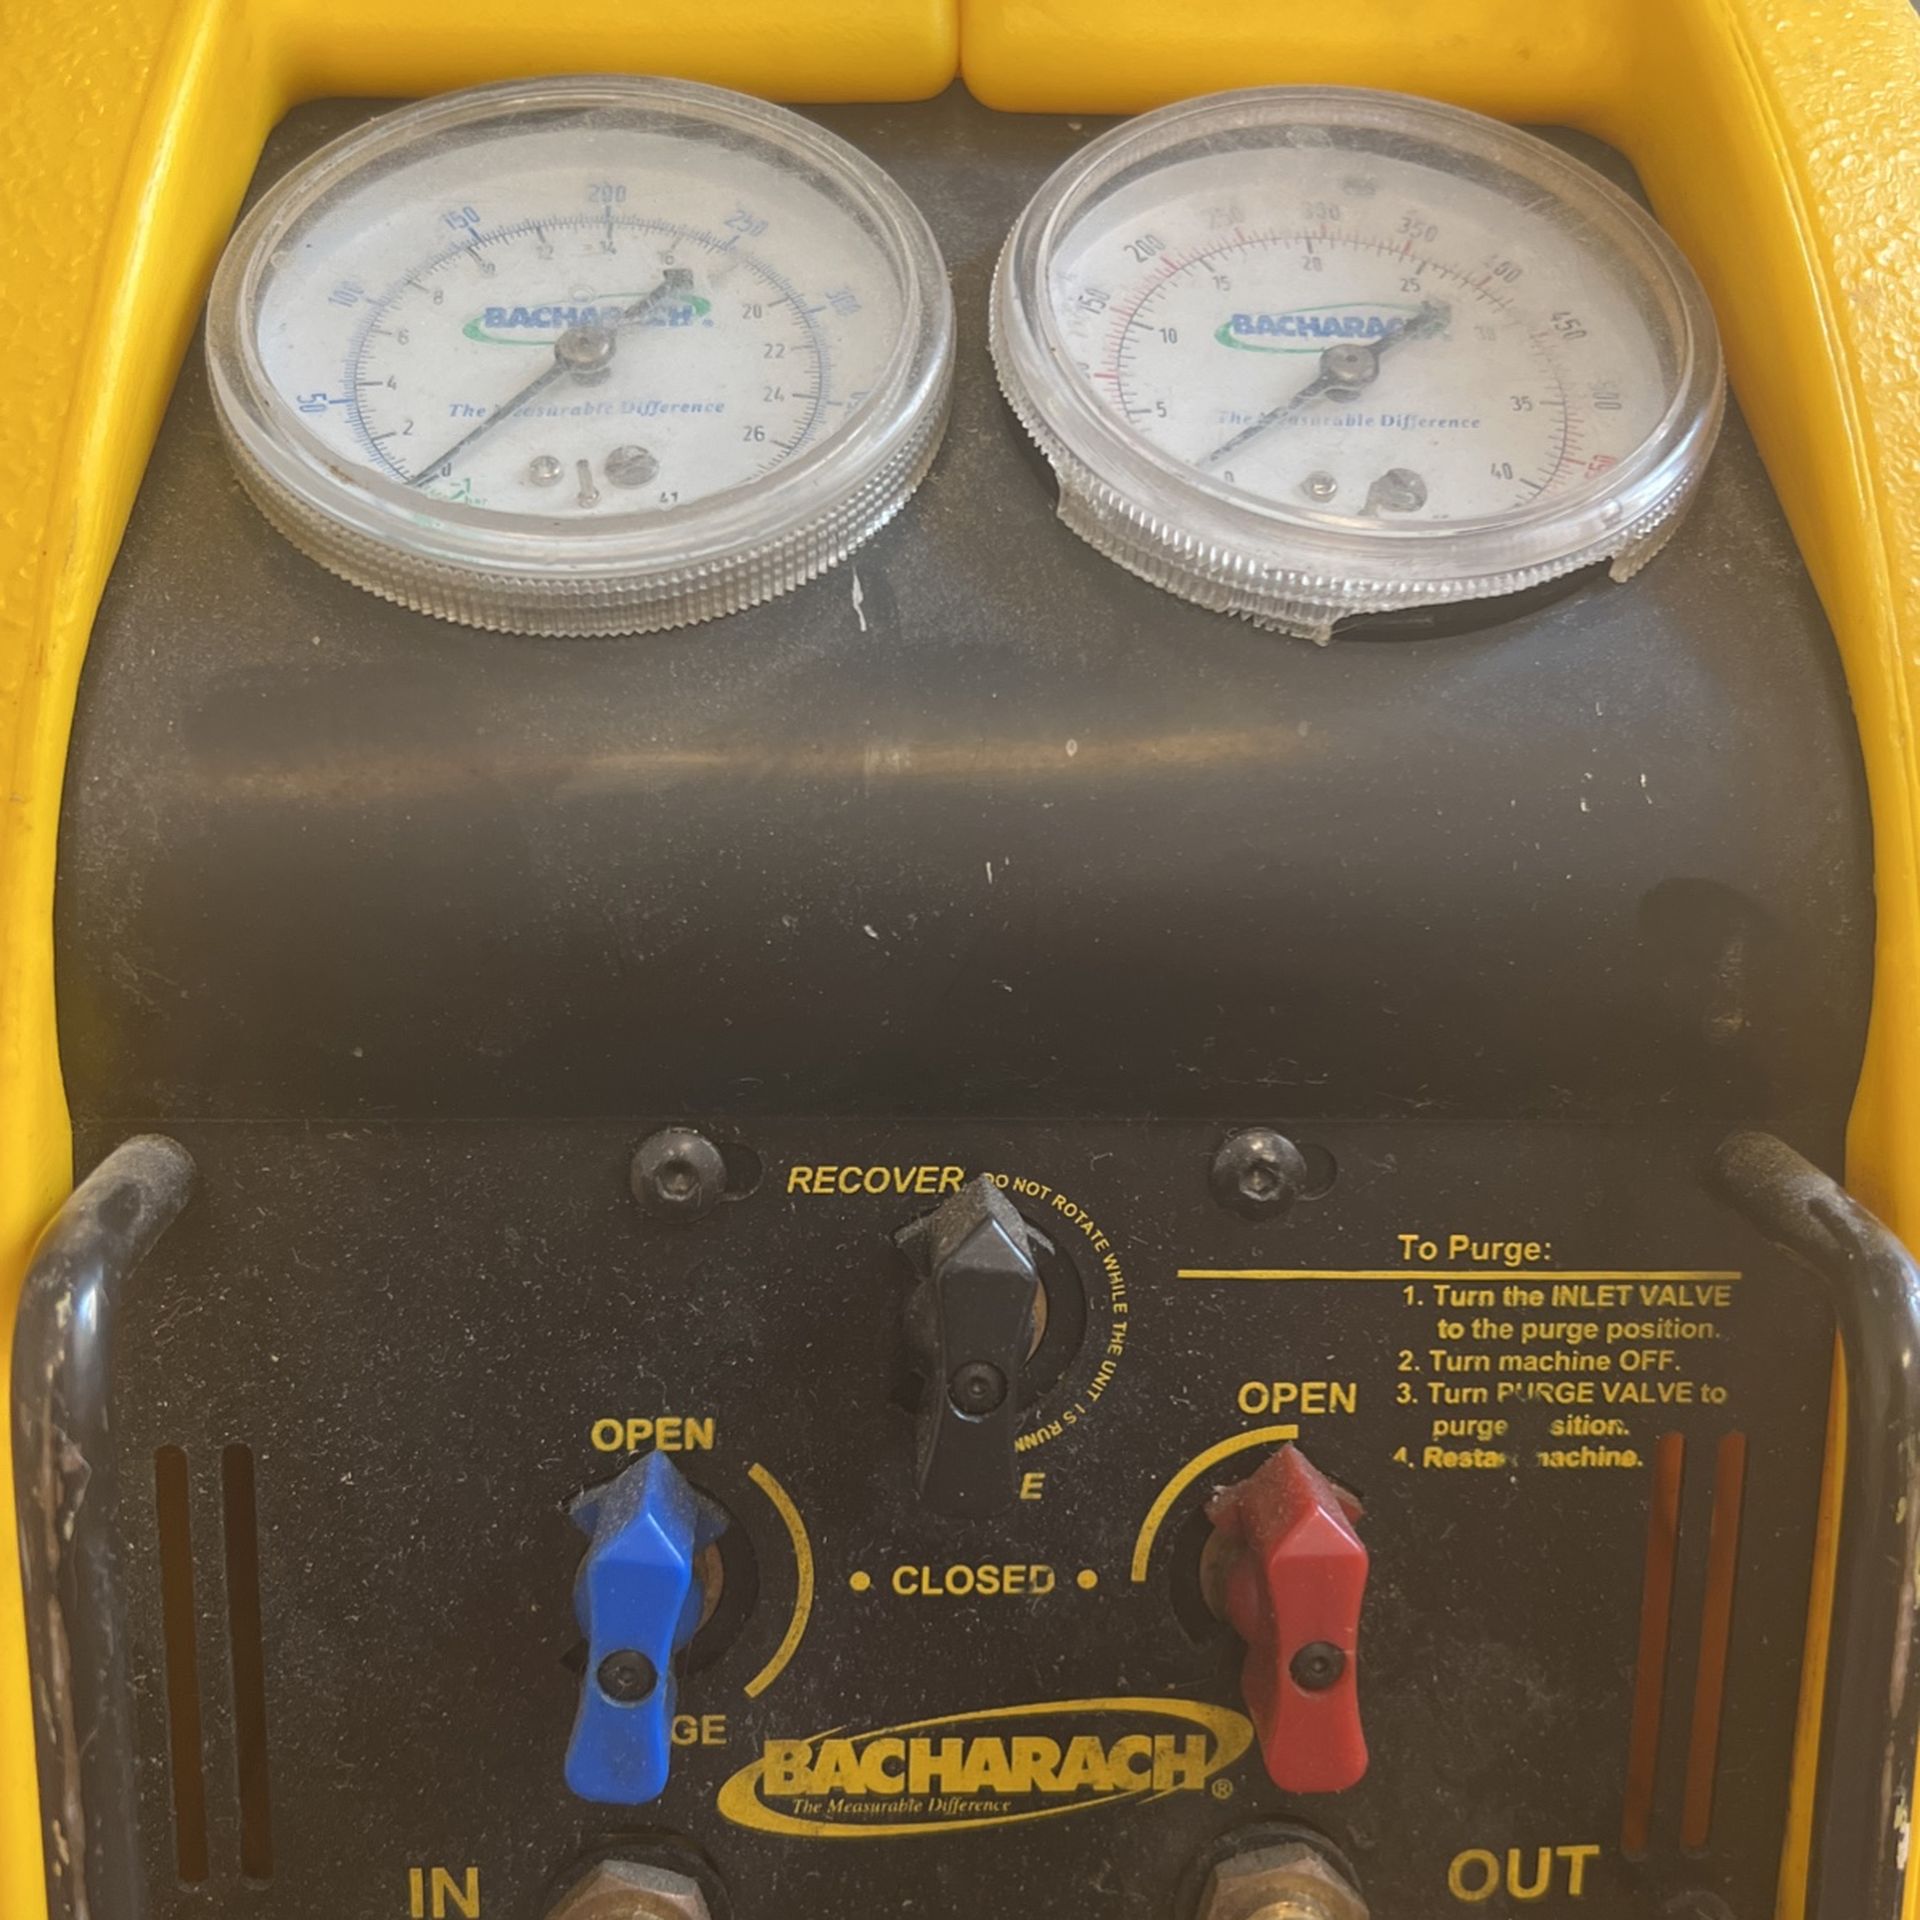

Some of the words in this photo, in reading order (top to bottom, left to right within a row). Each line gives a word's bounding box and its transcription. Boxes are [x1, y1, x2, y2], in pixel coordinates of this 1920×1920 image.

[444, 206, 481, 230] 150
[1396, 216, 1439, 242] 350
[1124, 233, 1166, 263] 200
[1400, 277, 1421, 293] 25
[742, 304, 763, 320] 20
[1160, 328, 1178, 344] 10
[1551, 311, 1588, 341] 450
[763, 343, 785, 360] 22
[386, 375, 397, 390] 4
[763, 386, 785, 402] 24
[297, 392, 328, 413] 50
[448, 403, 486, 418] The
[493, 400, 614, 419] easurable
[621, 399, 727, 418] Difference
[1156, 401, 1168, 418] 5
[1510, 395, 1533, 412] 35
[402, 419, 415, 437] 2
[742, 425, 766, 442] 26
[1491, 462, 1513, 480] 40
[786, 1165, 965, 1195] RECOVER
[1012, 1175, 1053, 1201] NOT
[1050, 1193, 1111, 1253] ROTATE
[1397, 1234, 1438, 1261] To
[1448, 1234, 1552, 1268] Purge:
[1102, 1252, 1128, 1314] WHILE
[1402, 1285, 1425, 1306] 1.
[1433, 1285, 1495, 1307] Turn
[1502, 1285, 1544, 1307] the
[1551, 1285, 1633, 1307] INLET
[1638, 1285, 1732, 1307] VALVE
[1106, 1320, 1128, 1356] THE
[1437, 1319, 1465, 1341] to
[1472, 1318, 1514, 1340] the
[1521, 1321, 1599, 1345] purge
[1606, 1318, 1721, 1344] position.
[1397, 1350, 1420, 1372] 2.
[1428, 1350, 1490, 1372] Turn
[1498, 1350, 1612, 1372] machine
[1618, 1350, 1681, 1372] OFF.
[1086, 1360, 1118, 1403] UNIT
[1396, 1382, 1418, 1404] 3.
[1427, 1382, 1488, 1404] Turn
[1602, 1381, 1693, 1404] VALVE
[1700, 1382, 1728, 1404] to
[1236, 1380, 1359, 1415] OPEN
[590, 1416, 716, 1451] OPEN
[1013, 1418, 1064, 1453] RUNN
[1432, 1417, 1509, 1442] purge
[891, 1564, 1057, 1595] CLOSED
[762, 1734, 1208, 1796] BACHARACH
[792, 1797, 822, 1814] The
[826, 1797, 924, 1815] Measurable
[927, 1795, 1012, 1816] Difference
[1447, 1844, 1601, 1902] OUT
[408, 1866, 481, 1919] IN
